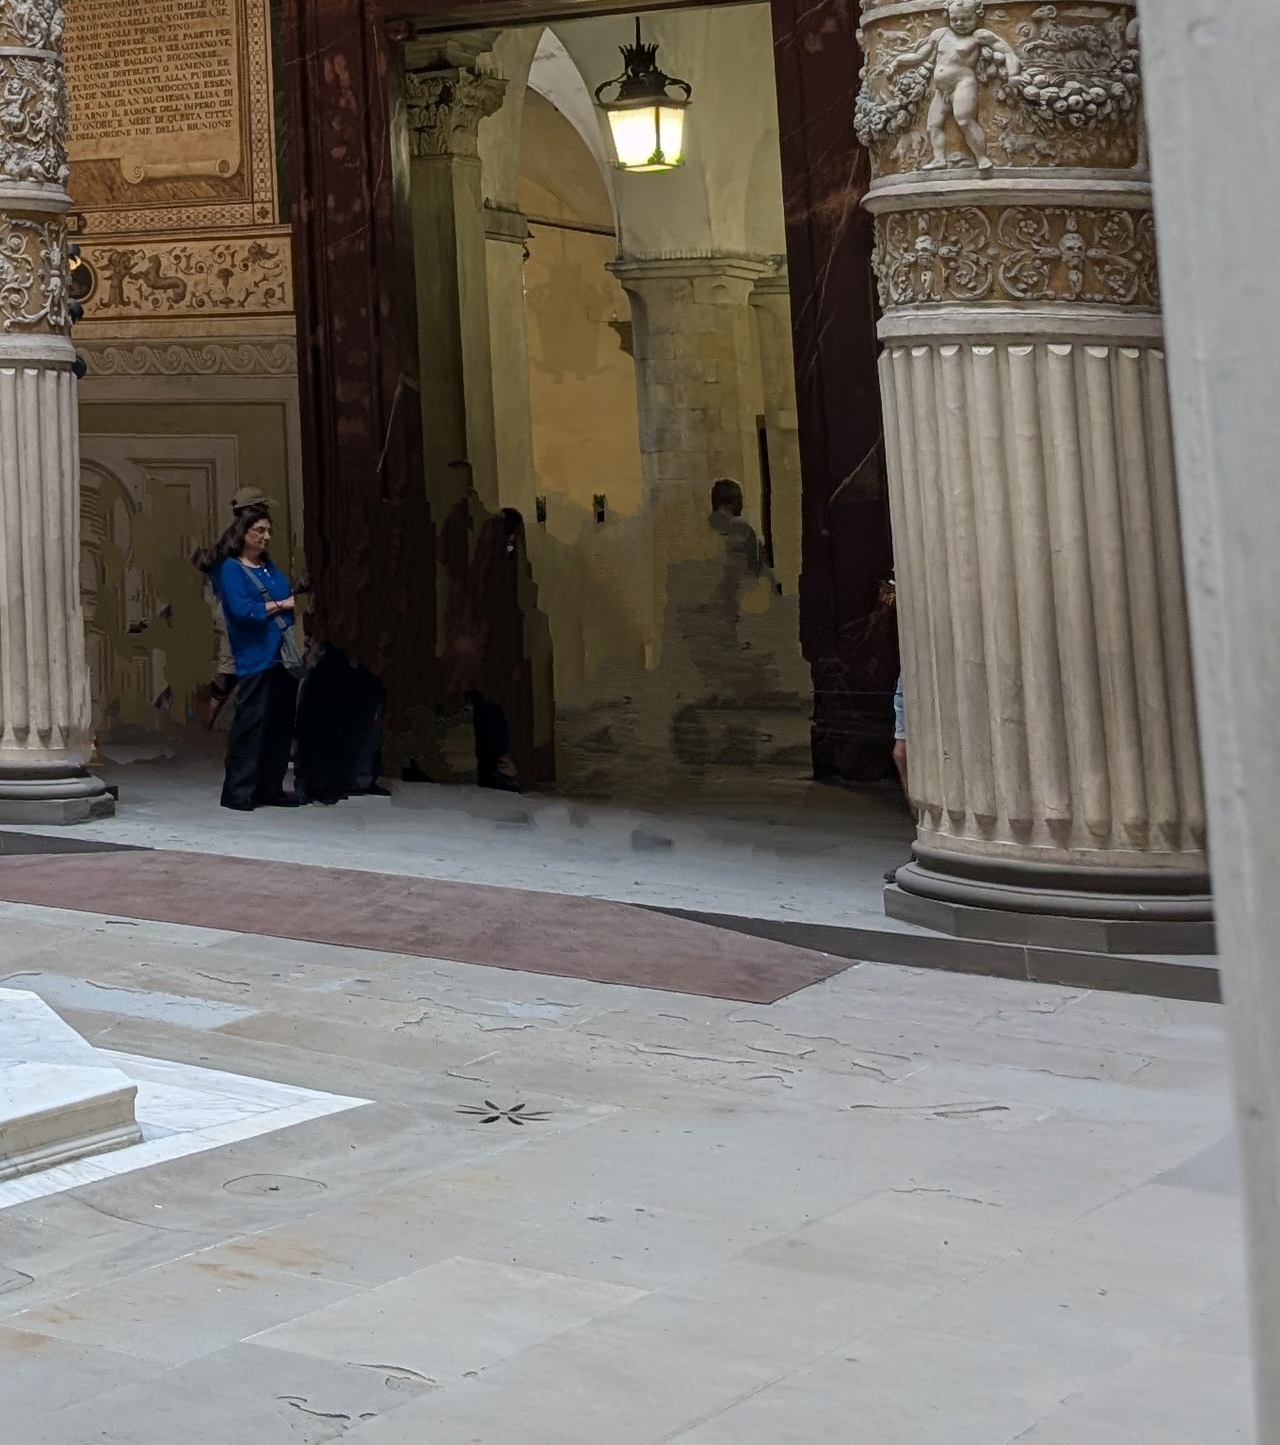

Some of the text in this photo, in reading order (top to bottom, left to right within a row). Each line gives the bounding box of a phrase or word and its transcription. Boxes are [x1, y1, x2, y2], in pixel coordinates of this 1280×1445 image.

[128, 0, 140, 7] DA
[177, 0, 207, 11] DELLE
[154, 16, 164, 25] DI
[76, 28, 131, 42] MARIGNOLLI
[183, 30, 213, 41] PARETI
[215, 28, 232, 38] PER
[113, 47, 148, 58] DIPINTE
[151, 45, 164, 54] DA
[165, 40, 217, 52] SEBASTIANO
[74, 64, 87, 72] DA
[83, 72, 109, 83] QUASI
[163, 64, 170, 73] O
[174, 61, 212, 72] ALMENO
[72, 82, 107, 93] FURONO
[109, 75, 161, 89] RICHIAMATI
[165, 73, 188, 83] ALLA
[75, 103, 81, 112] E
[98, 101, 110, 109] LA
[114, 97, 140, 108] GRAN
[143, 92, 191, 105] DUCHESSA
[194, 90, 220, 100] ELISA
[223, 88, 233, 98] DI
[111, 110, 120, 118] IL
[123, 105, 157, 117] BARONE
[154, 115, 164, 124] DI
[167, 112, 202, 124] QUESTA
[155, 124, 184, 134] DELLA
[186, 119, 232, 132] RIUNIONE
